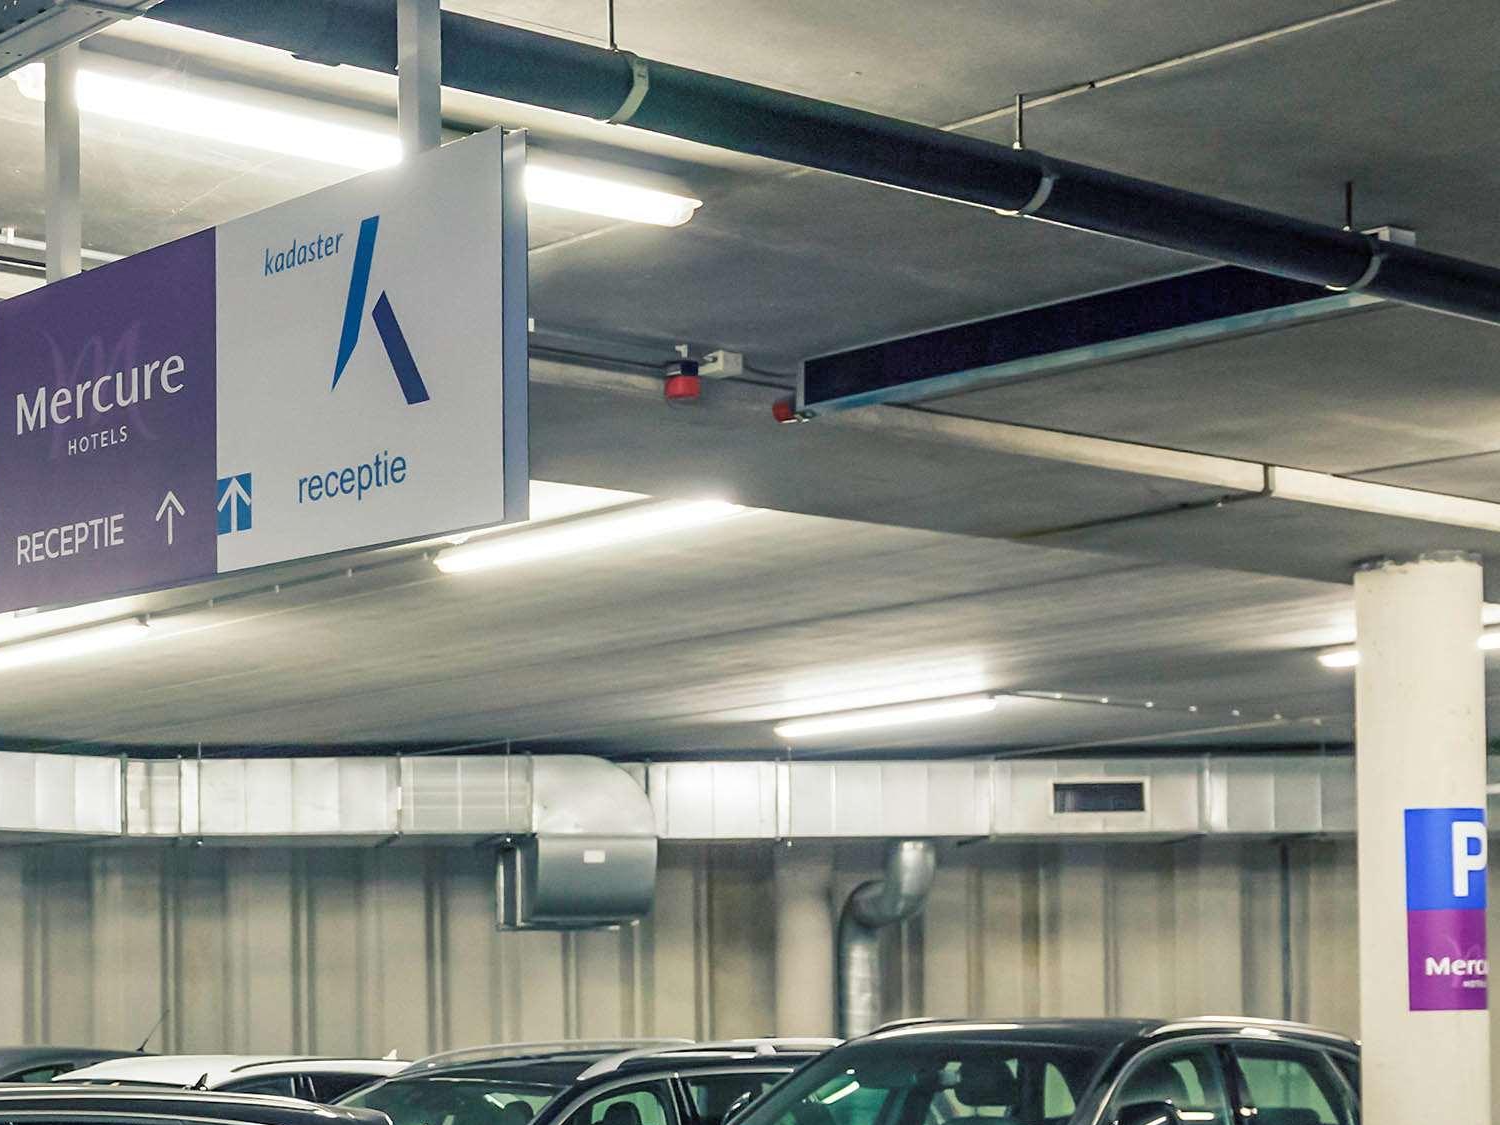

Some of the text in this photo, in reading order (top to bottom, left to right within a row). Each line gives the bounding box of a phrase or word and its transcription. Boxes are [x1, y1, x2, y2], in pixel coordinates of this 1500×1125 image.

[264, 232, 344, 277] kadaster
[15, 354, 186, 436] Mercure
[67, 424, 129, 457] HOTELS
[298, 449, 407, 504] receptie
[16, 512, 125, 566] RECEPTIE
[1451, 820, 1488, 898] P
